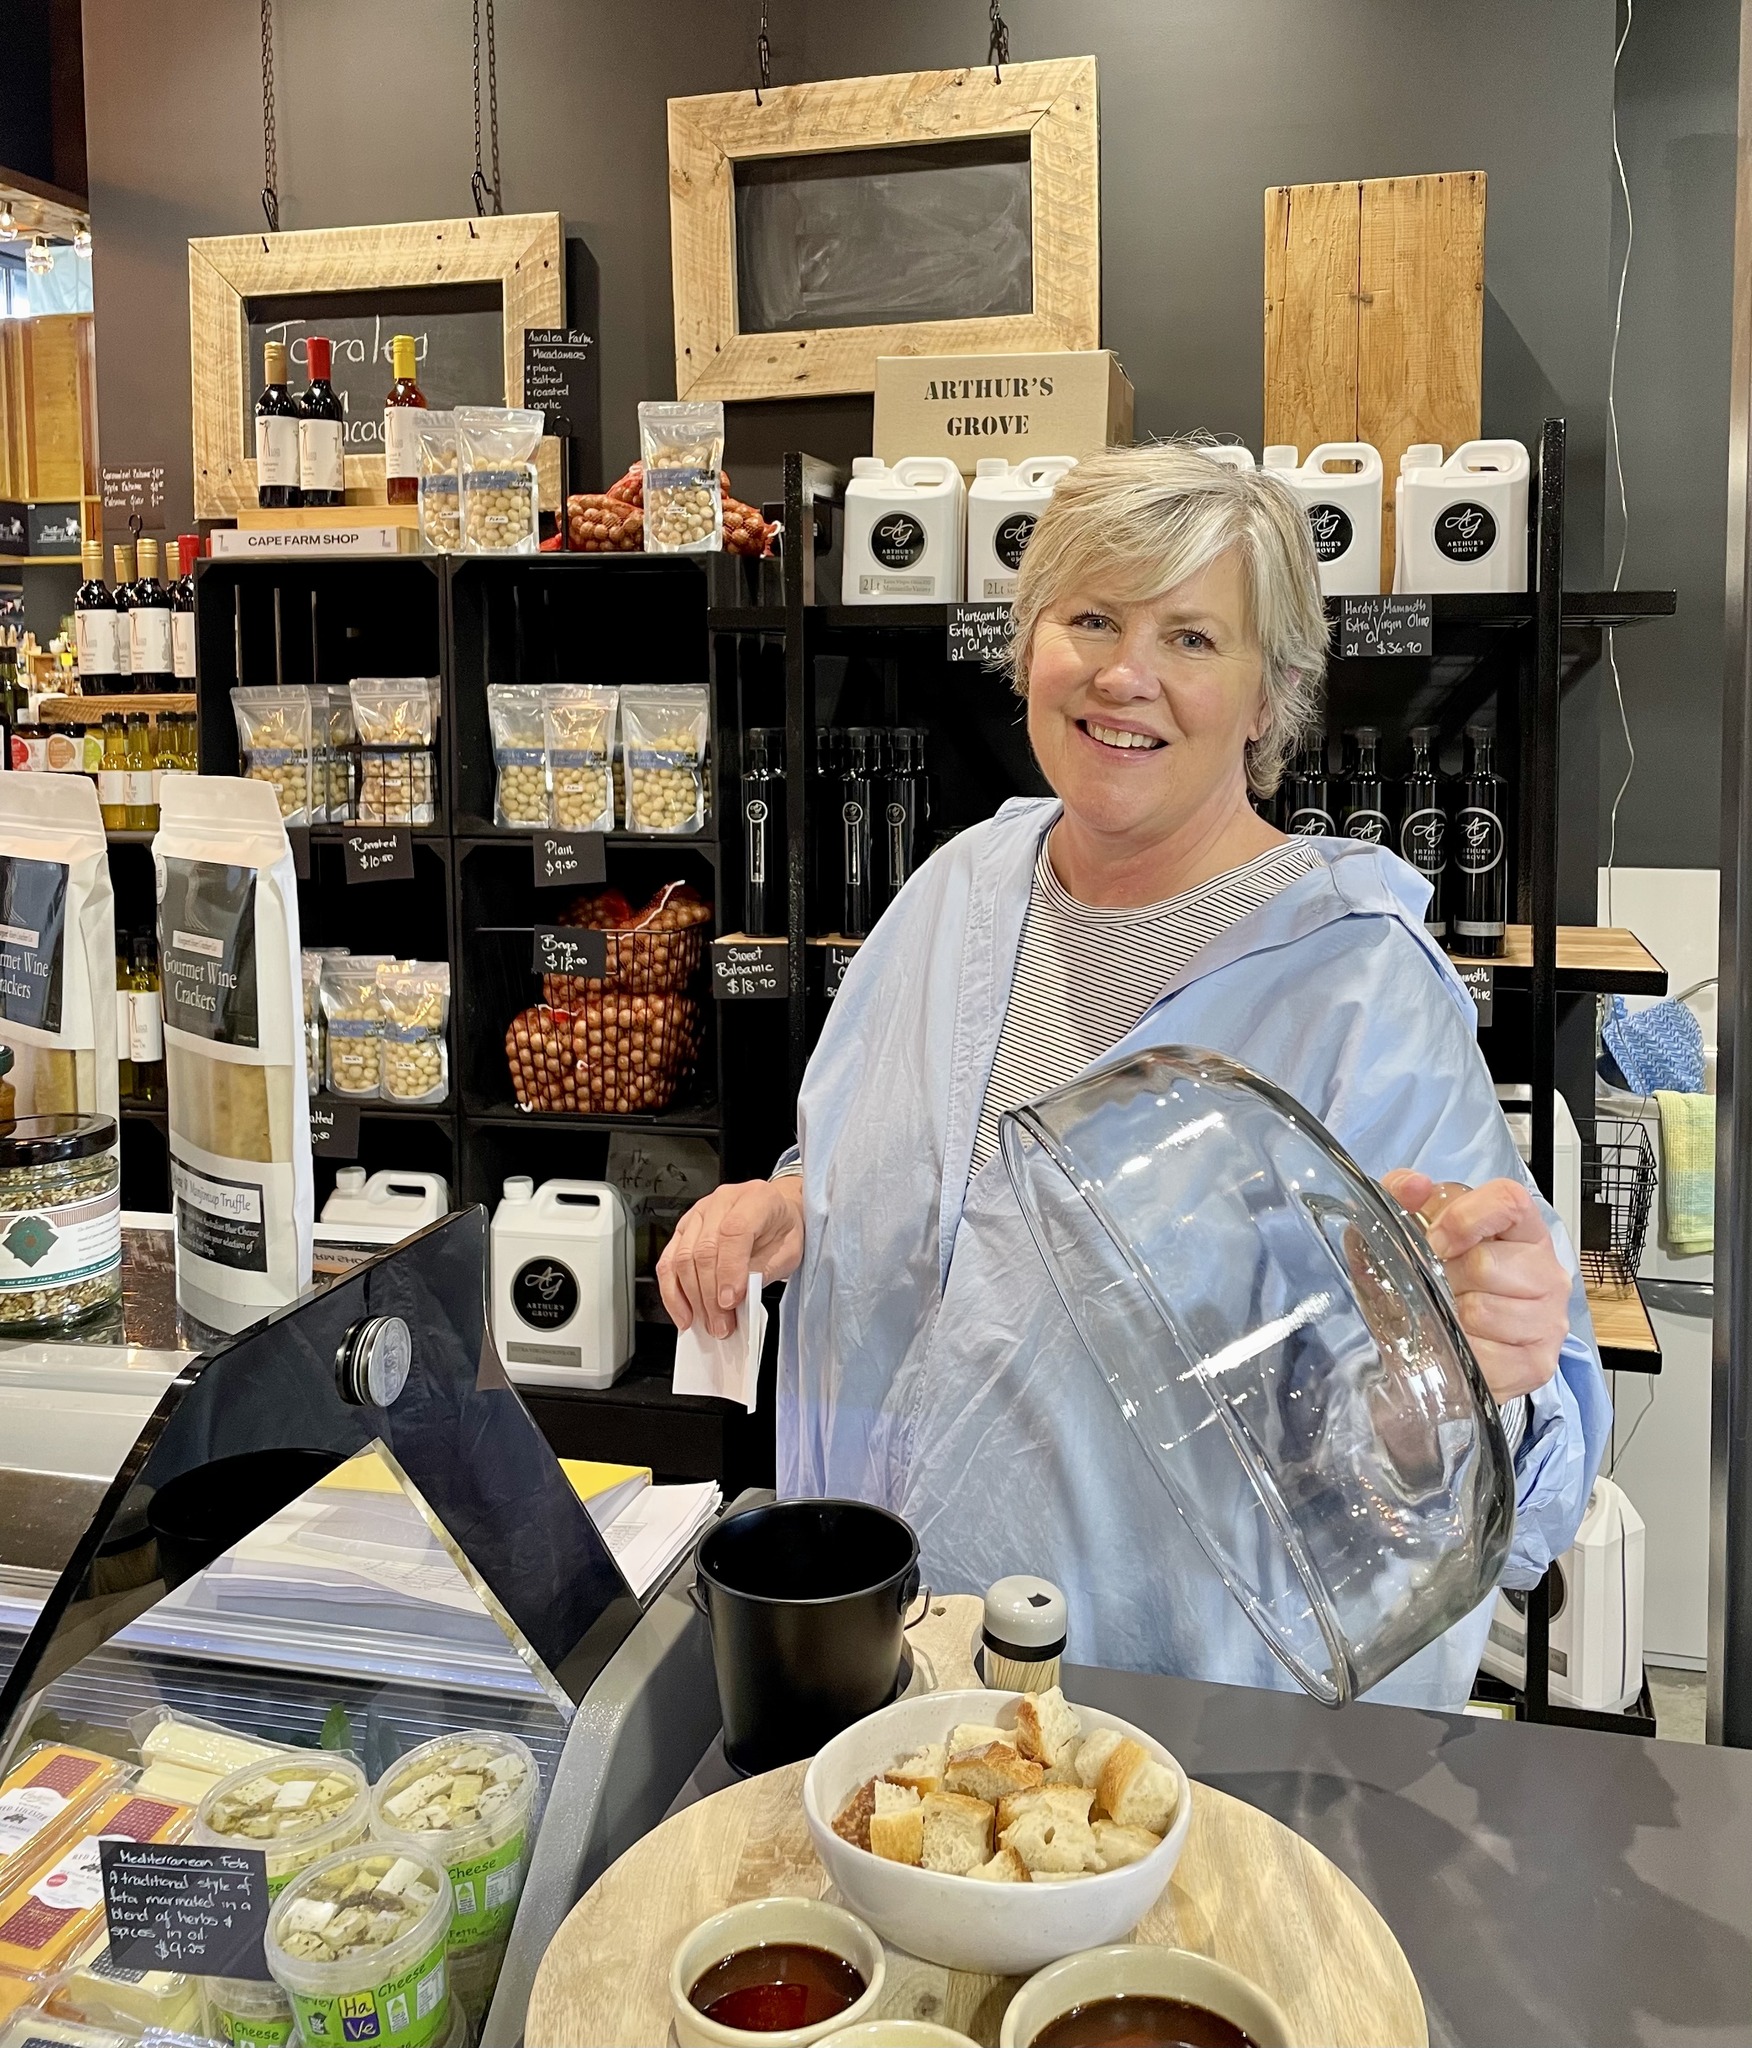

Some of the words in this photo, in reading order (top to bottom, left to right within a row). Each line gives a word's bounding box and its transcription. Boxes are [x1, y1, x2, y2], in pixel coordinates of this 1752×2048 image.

[568, 329, 594, 344] Farm
[532, 348, 586, 360] Macadamias
[532, 363, 557, 376] plain
[532, 372, 563, 384] salted
[533, 384, 569, 397] roasted
[924, 376, 1054, 401] ARTHUR'S
[533, 398, 562, 409] garlic
[946, 415, 1030, 437] GROVE
[248, 536, 283, 547] CAPE
[283, 535, 323, 546] FARM
[323, 534, 360, 545] SHOP
[1446, 540, 1484, 548] ARTHUR'S
[881, 548, 915, 556] ARTHUR'S
[885, 554, 910, 562] GROVE
[1345, 599, 1380, 622] Hardy's
[1383, 595, 1427, 615] Mammoth
[949, 622, 974, 638] Extra
[977, 621, 1002, 643] Virgin
[1345, 616, 1370, 634] Extra
[1373, 608, 1403, 638] Virgin
[544, 839, 575, 856] Plain
[540, 934, 579, 957] Bags
[727, 946, 763, 962] Sweet
[24, 951, 50, 978] Wine
[162, 949, 206, 982] Gourmet
[206, 961, 238, 989] Wine
[715, 962, 775, 977] Balsamic
[0, 973, 32, 999] rackers
[726, 978, 777, 995] $18.90
[174, 979, 217, 1013] Crackers
[309, 1111, 334, 1126] alted
[220, 1192, 251, 1215] Truffle
[237, 1225, 260, 1238] Cheese
[246, 1240, 255, 1254] of
[526, 1302, 565, 1311] ARTHUR'S
[531, 1309, 559, 1318] GROVE
[119, 1849, 214, 1868] Mediterranean
[220, 1855, 250, 1870] Feta
[447, 1859, 497, 1880] Cheese
[109, 1869, 118, 1883] A
[120, 1871, 189, 1890] traditional
[197, 1876, 231, 1895] style
[236, 1876, 252, 1896] of
[110, 1885, 138, 1903] feta
[145, 1892, 215, 1908] marinated
[221, 1900, 236, 1911] in
[241, 1902, 252, 1911] a
[111, 1906, 149, 1922] blend
[155, 1909, 172, 1929] of
[177, 1911, 218, 1927] herbs
[110, 1926, 156, 1940] spices
[166, 1929, 182, 1940] in
[377, 1962, 427, 1999] Cheese
[343, 1998, 373, 2017] Ha
[234, 2021, 280, 2040] Cheese
[346, 2018, 376, 2040] Ve
